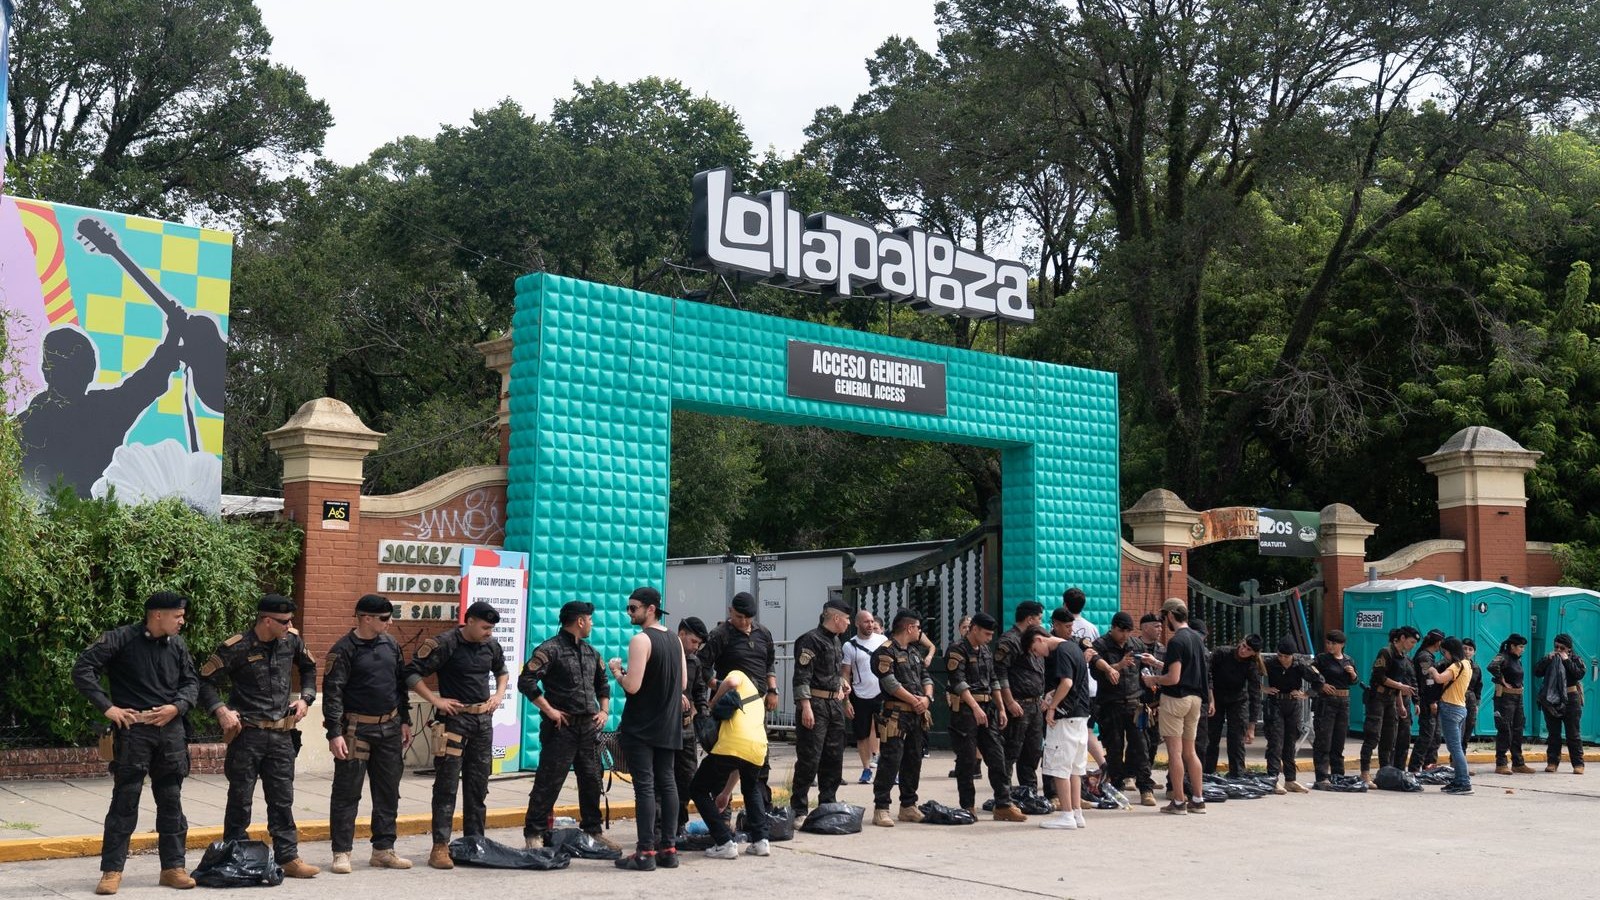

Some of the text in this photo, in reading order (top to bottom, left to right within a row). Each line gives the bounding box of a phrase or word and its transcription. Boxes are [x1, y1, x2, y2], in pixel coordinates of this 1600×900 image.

[812, 349, 926, 389] ACCESO GENERAL
[834, 378, 906, 403] GENERAL ACCESS
[328, 507, 346, 518] A&S
[382, 543, 452, 565] JOCKEY
[757, 562, 776, 572] Basani
[386, 576, 461, 593] HIPODR
[411, 604, 442, 619] SAN
[1357, 612, 1382, 622] Basani
